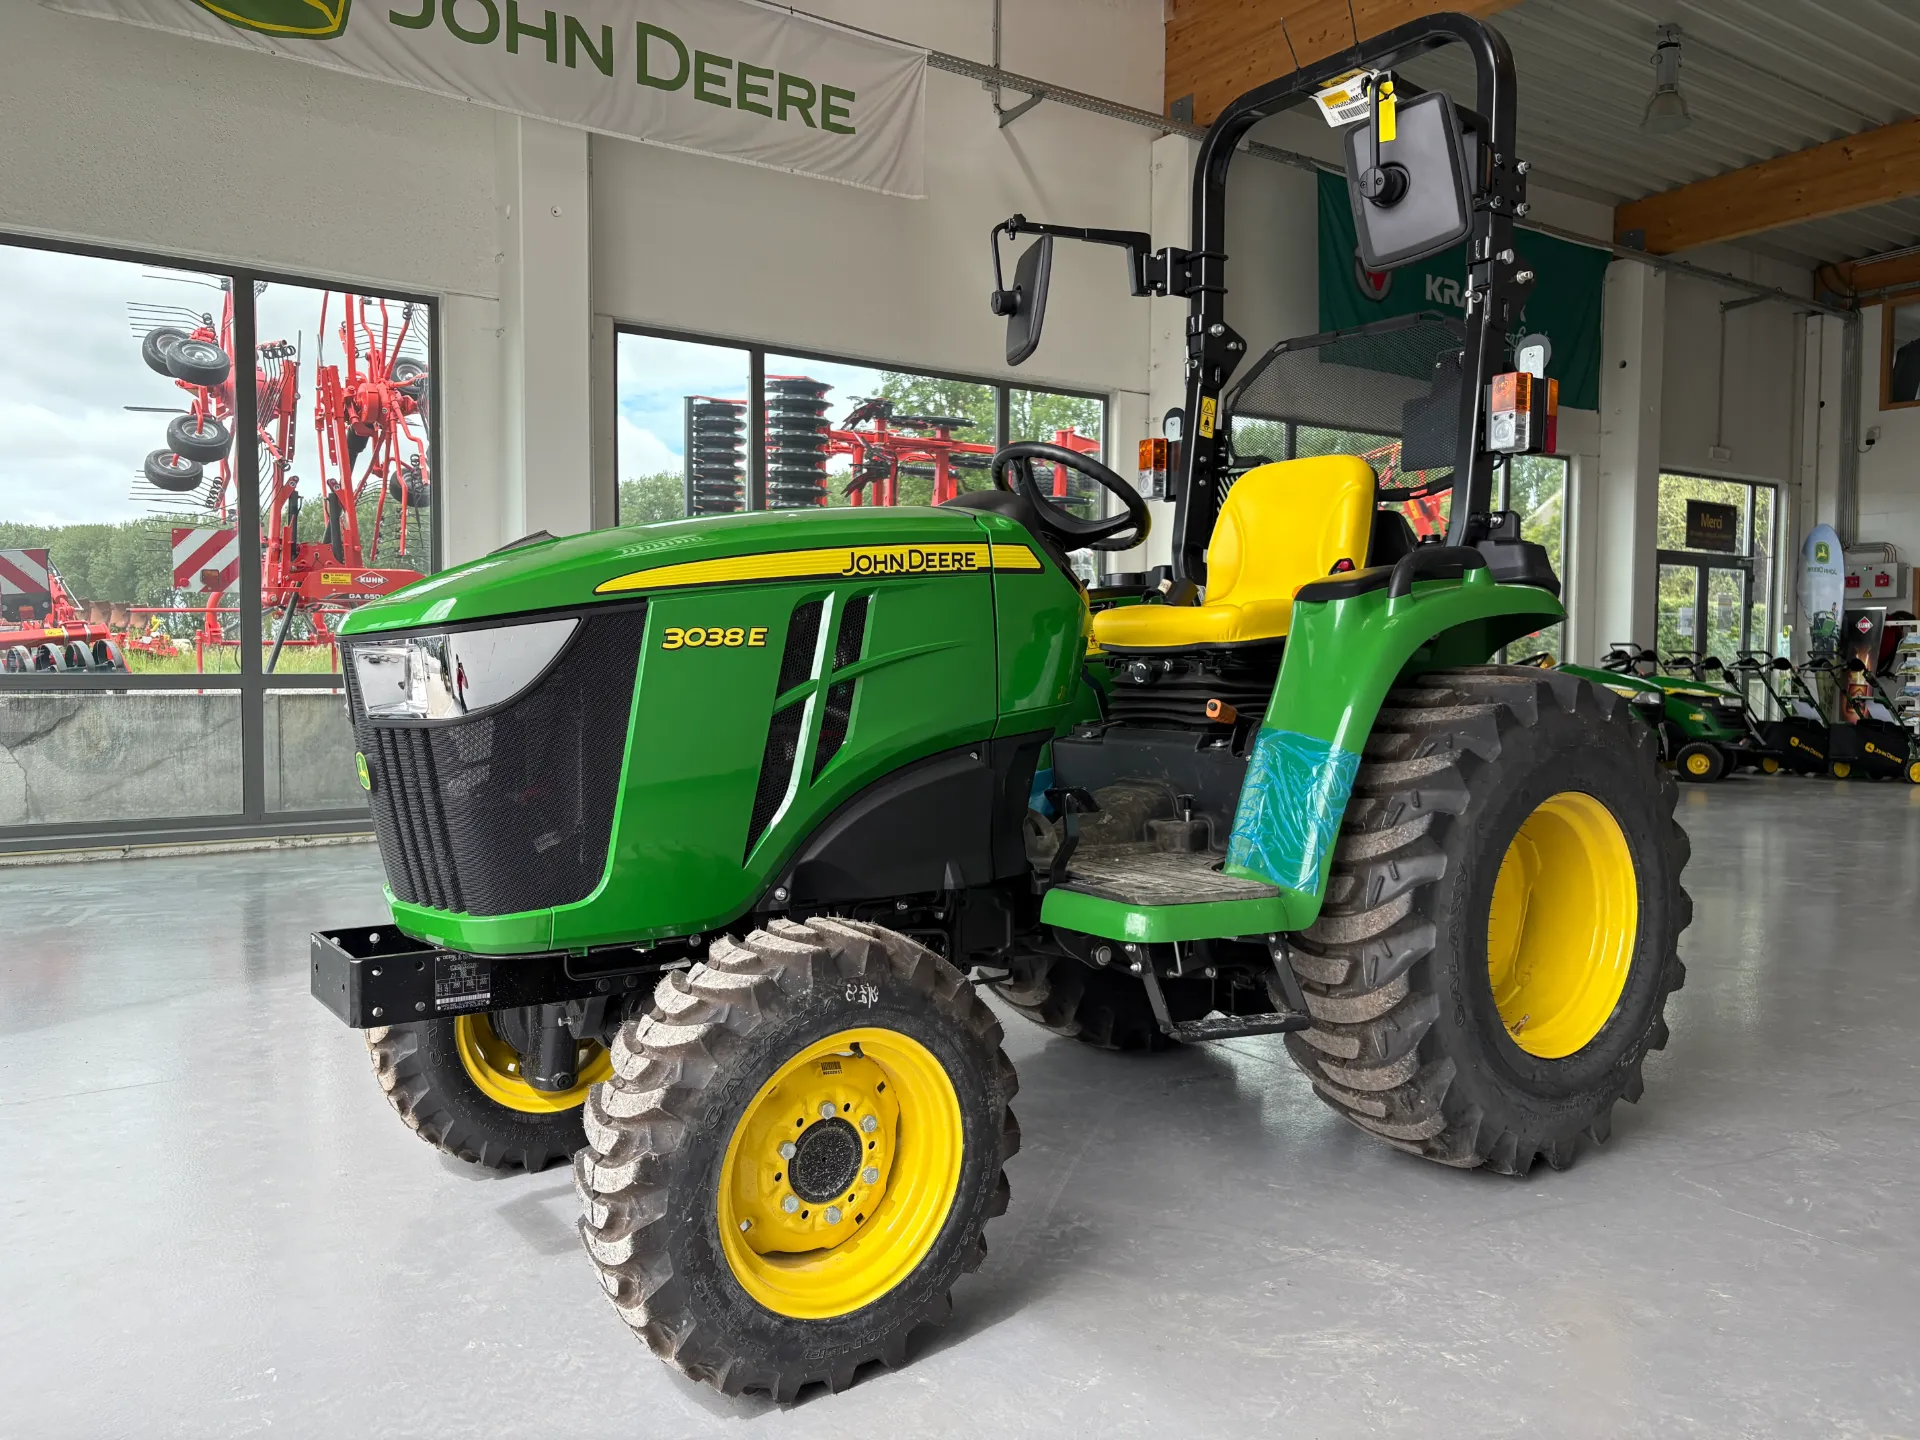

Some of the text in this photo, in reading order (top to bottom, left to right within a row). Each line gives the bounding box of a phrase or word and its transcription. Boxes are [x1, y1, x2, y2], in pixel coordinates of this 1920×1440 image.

[636, 21, 857, 135] DEERE
[1700, 512, 1723, 530] Merci
[359, 576, 384, 584] KUHN
[842, 549, 976, 575] JOHN DEERE
[1445, 860, 1470, 1028] GALAXY
[704, 998, 834, 1130] GALAXY
